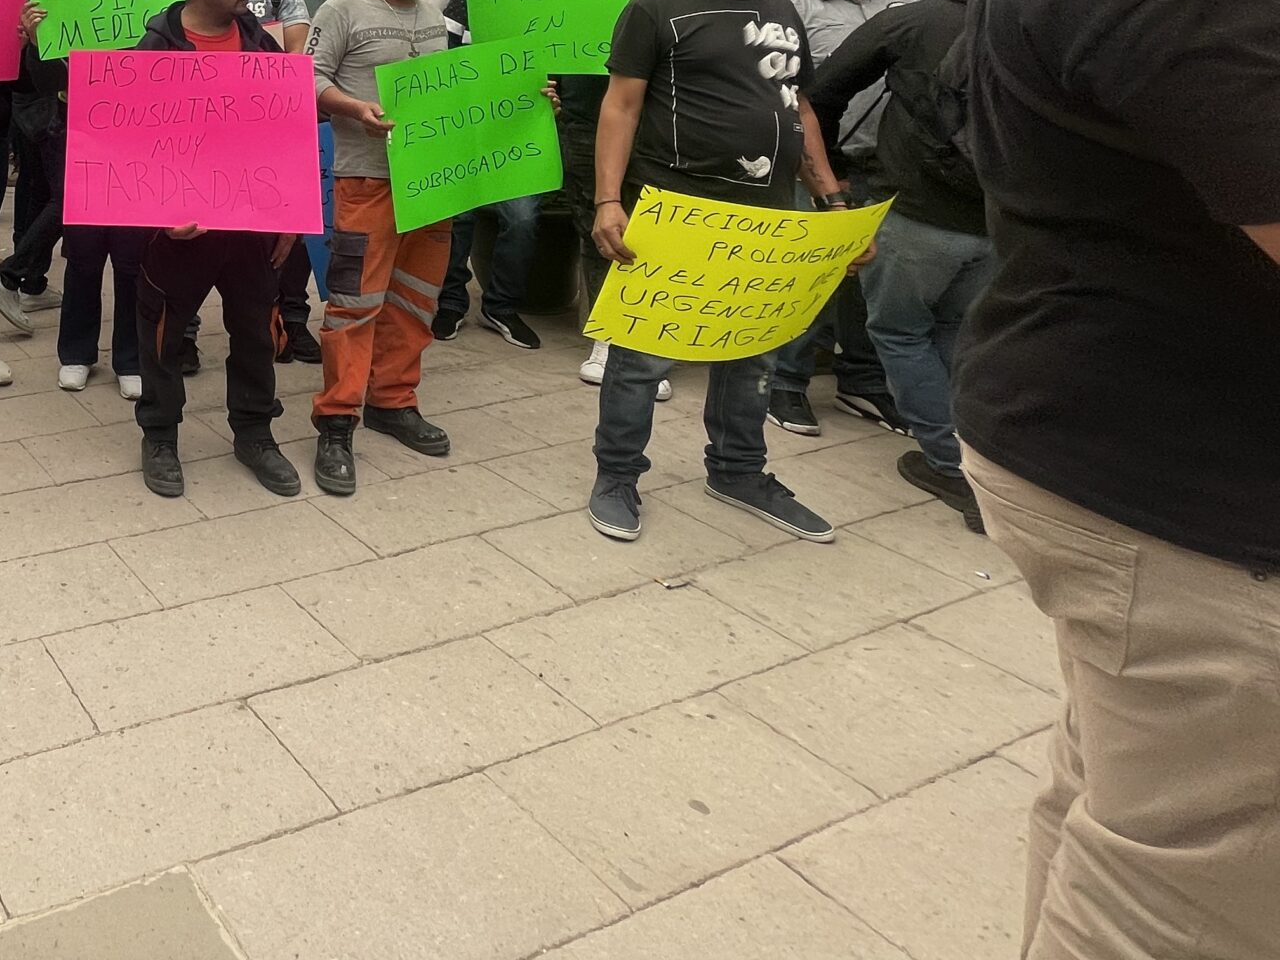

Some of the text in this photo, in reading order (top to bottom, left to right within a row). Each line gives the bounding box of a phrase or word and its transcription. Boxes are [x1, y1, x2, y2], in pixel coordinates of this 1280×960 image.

[523, 10, 565, 35] EN
[88, 54, 297, 87] LAS CITAS PARA
[393, 50, 535, 107] FALLAS DE
[88, 92, 303, 129] CONSULTAR SON
[403, 93, 535, 149] ESTUDIOS
[151, 132, 207, 168] MUY
[407, 141, 542, 199] SUBROGADOS
[640, 201, 810, 242] ATECIONES
[617, 262, 839, 295] EN EL AREA DE
[620, 285, 796, 320] URGENCIAS
[622, 313, 778, 349] TRIAGE
